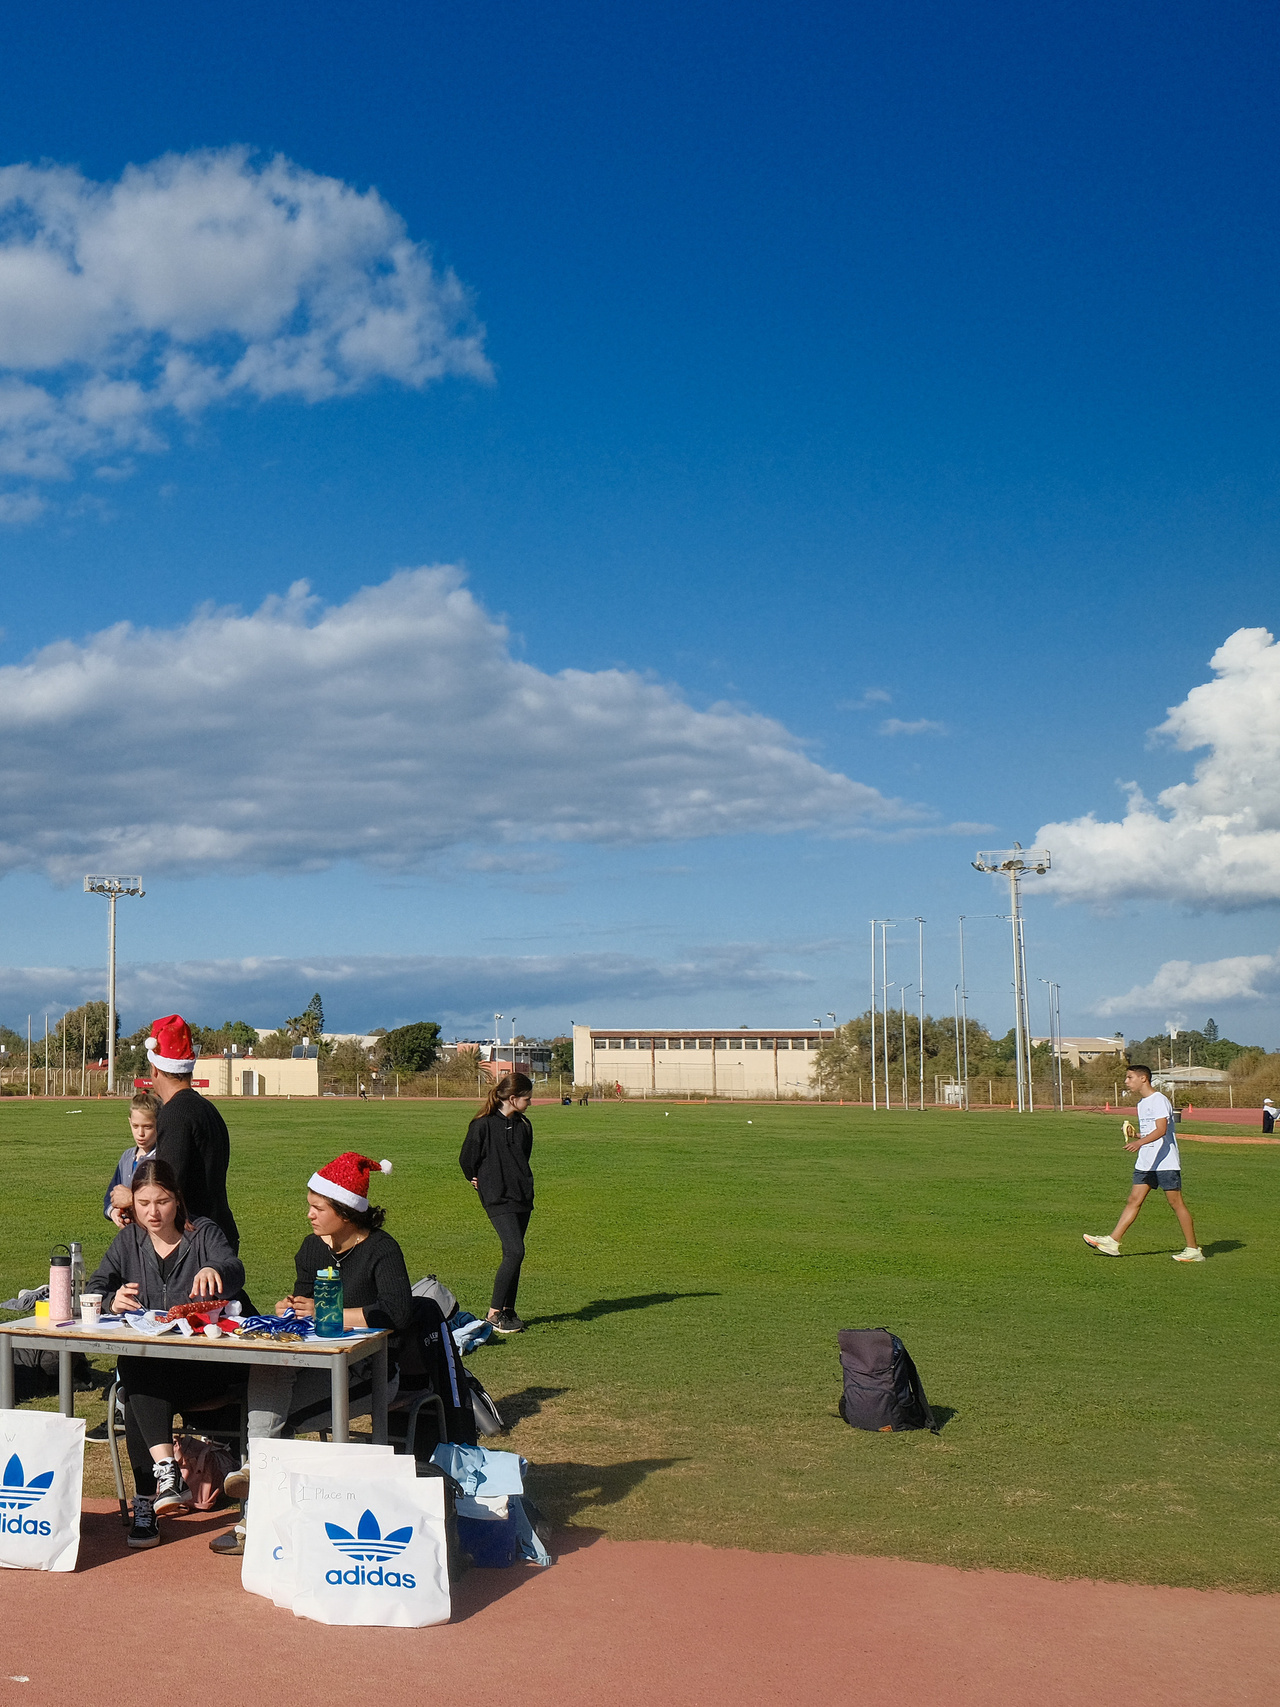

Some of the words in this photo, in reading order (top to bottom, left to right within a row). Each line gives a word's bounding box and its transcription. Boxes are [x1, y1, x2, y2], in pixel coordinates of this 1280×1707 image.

[297, 1486, 313, 1503] 1
[315, 1487, 342, 1500] Place
[325, 1565, 416, 1589] adidas
